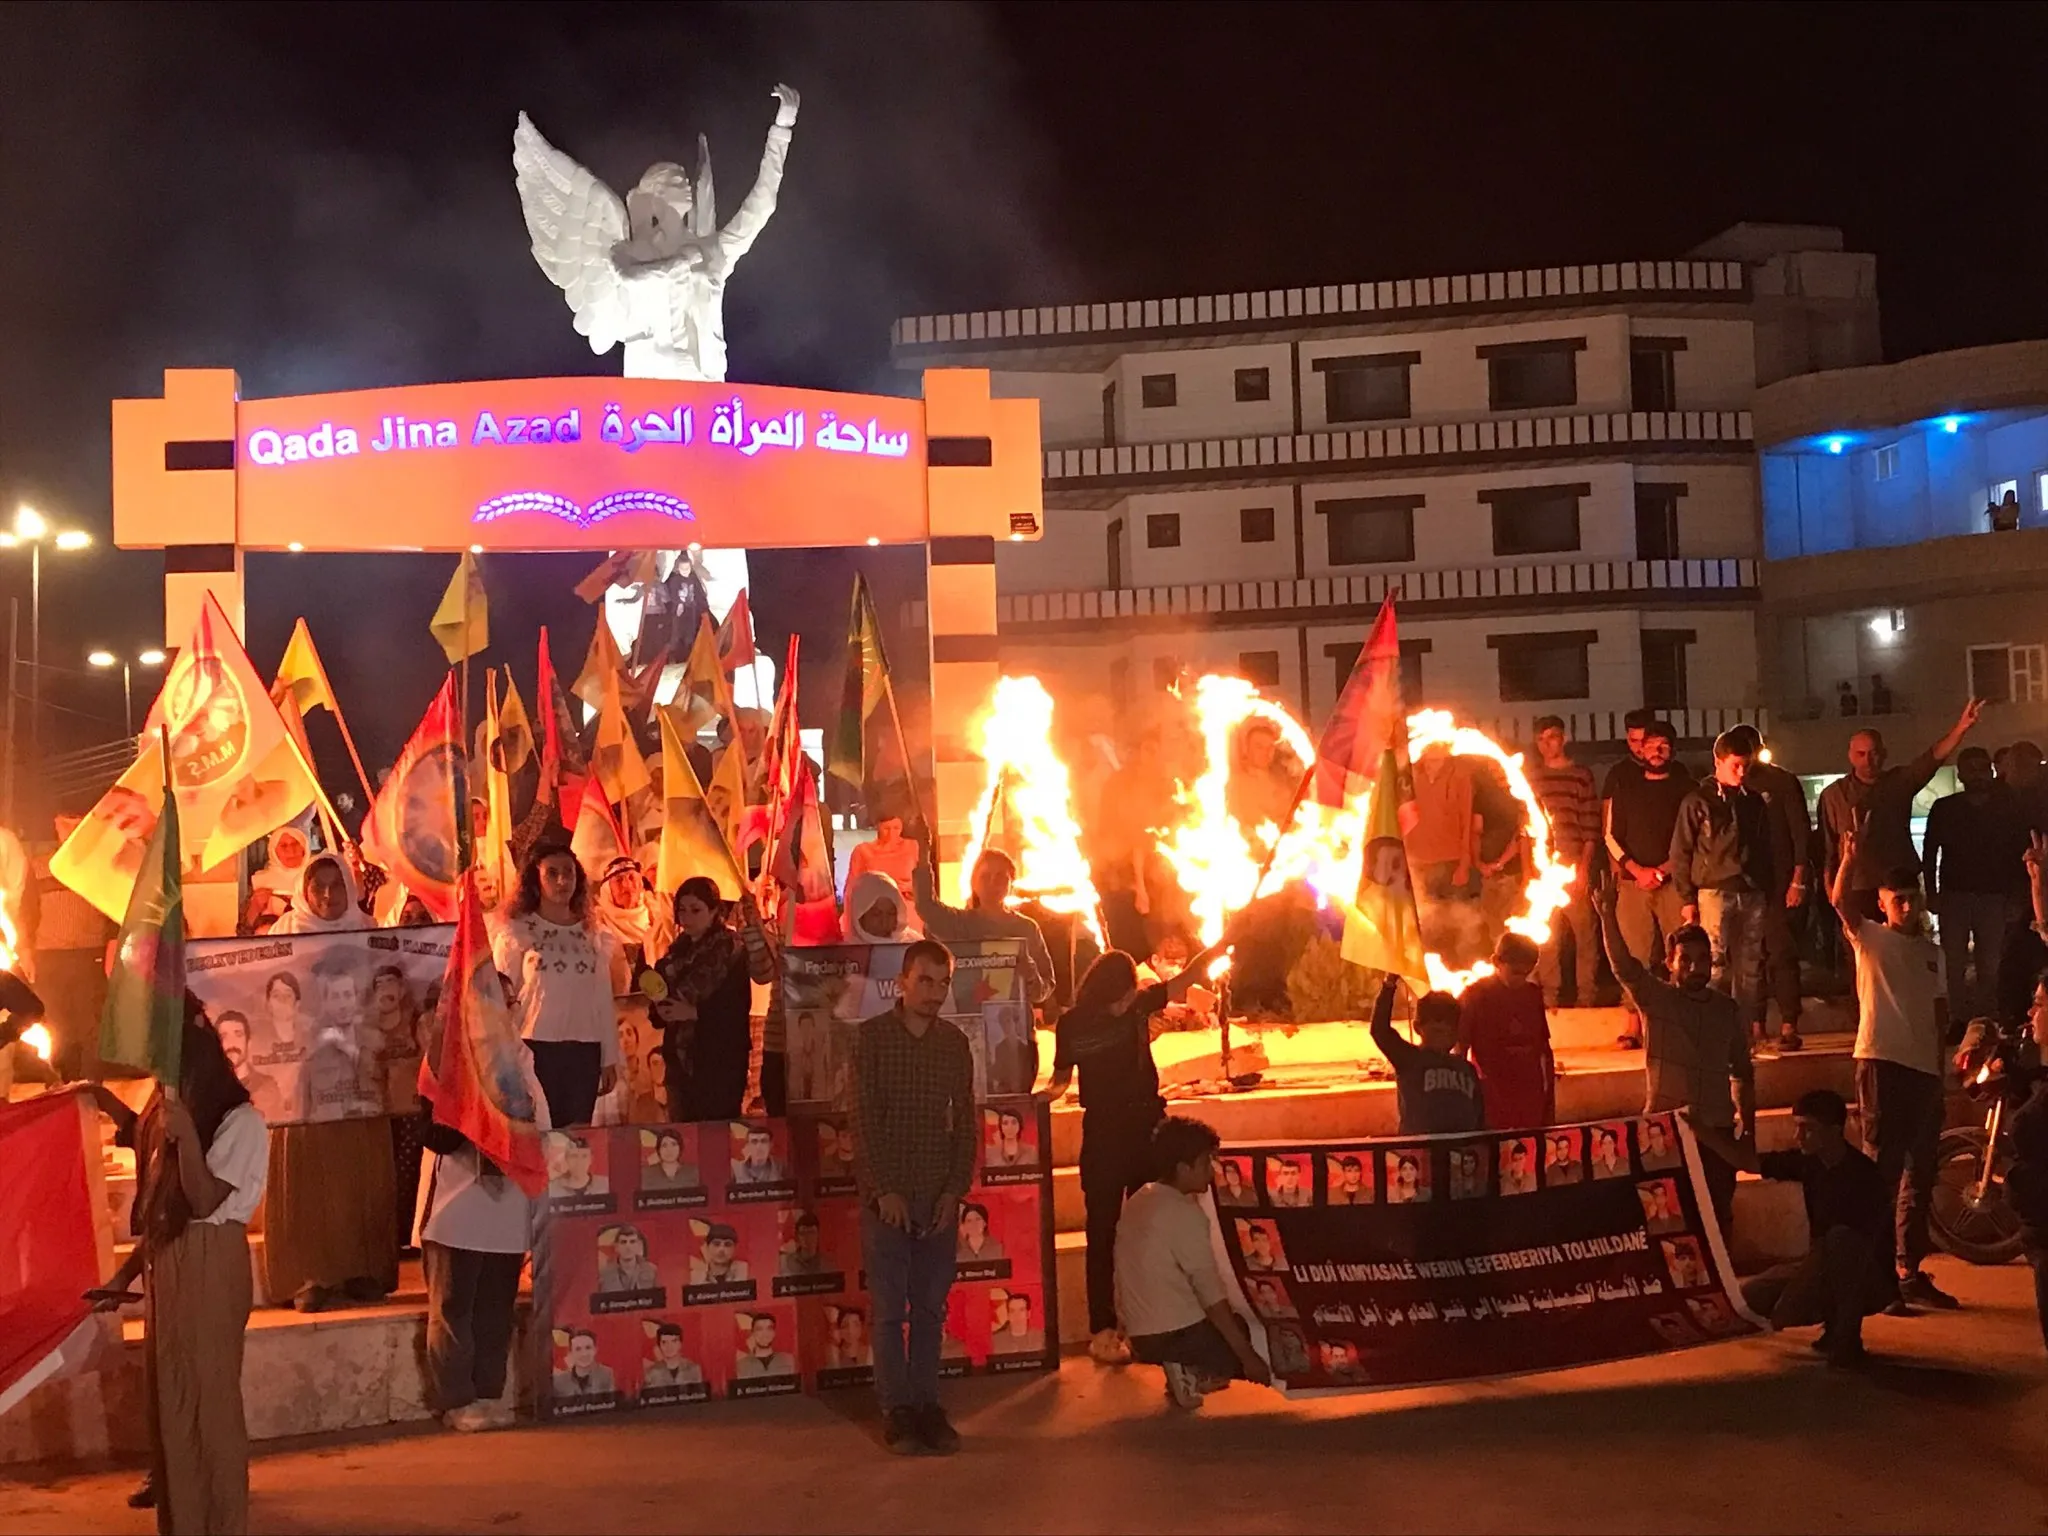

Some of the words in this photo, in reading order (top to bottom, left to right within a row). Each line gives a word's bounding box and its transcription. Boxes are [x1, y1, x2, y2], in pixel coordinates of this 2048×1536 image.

[247, 427, 359, 466] Qada
[371, 416, 458, 451] Jina
[471, 409, 580, 446] Azad
[601, 401, 694, 453] الحرة
[711, 397, 804, 457] المرأة
[816, 412, 910, 457] ساحة
[1293, 1265, 1310, 1283] LI
[1415, 1259, 1466, 1279] WERIN
[1465, 1245, 1563, 1275] SEFERBERIYA
[1561, 1225, 1649, 1262] TOLHILDANÊ
